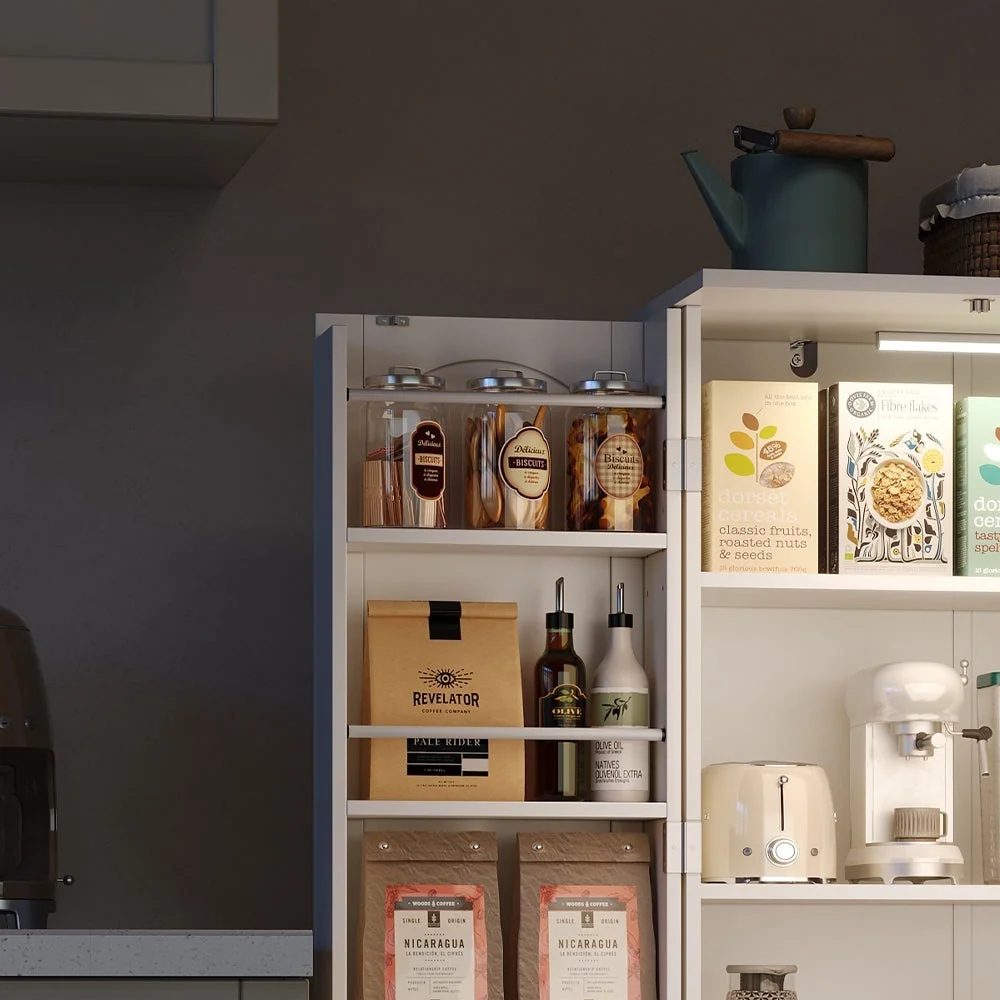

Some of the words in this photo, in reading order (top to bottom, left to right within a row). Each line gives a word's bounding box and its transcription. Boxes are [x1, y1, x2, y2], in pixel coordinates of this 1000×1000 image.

[881, 399, 907, 412] Fibre
[516, 459, 544, 468] BISCUITS
[604, 453, 639, 464] Biscuits
[719, 525, 766, 535] classic
[770, 526, 812, 538] fruits,
[719, 538, 771, 548] roasted
[775, 538, 808, 549] nuts
[719, 549, 731, 559] &
[734, 550, 773, 560] seeds
[413, 691, 480, 708] REVELATOR
[413, 738, 441, 746] PALE
[445, 738, 481, 747] RIDER
[595, 741, 612, 750] OLIVE
[613, 741, 624, 750] OIL
[595, 760, 620, 770] NATIVES
[623, 769, 643, 779] EXTRA
[404, 938, 465, 949] NICARAGUA
[558, 938, 618, 949] NICARAGUA
